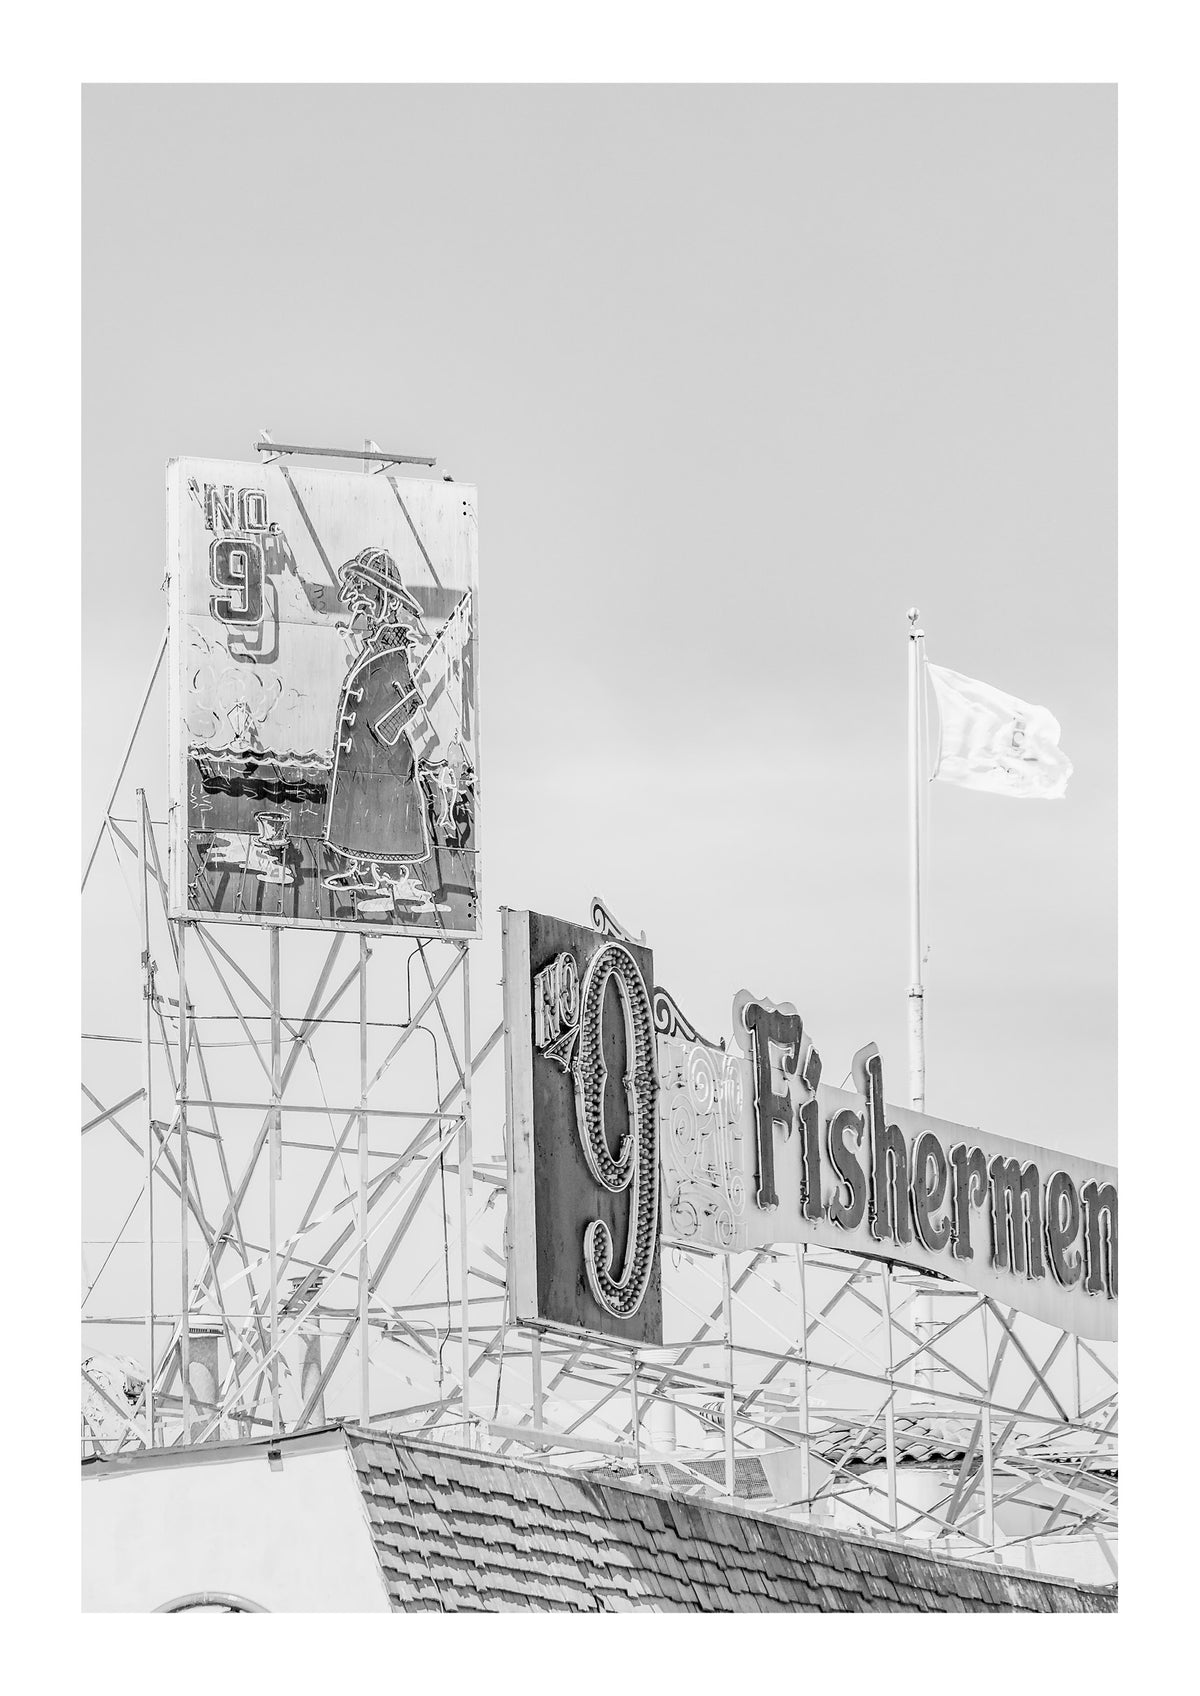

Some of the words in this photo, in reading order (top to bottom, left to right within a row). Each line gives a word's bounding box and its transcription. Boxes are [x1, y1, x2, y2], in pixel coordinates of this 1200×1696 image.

[209, 537, 265, 626] 9
[575, 942, 660, 1318] 9
[743, 1002, 1118, 1300] Fishermen
